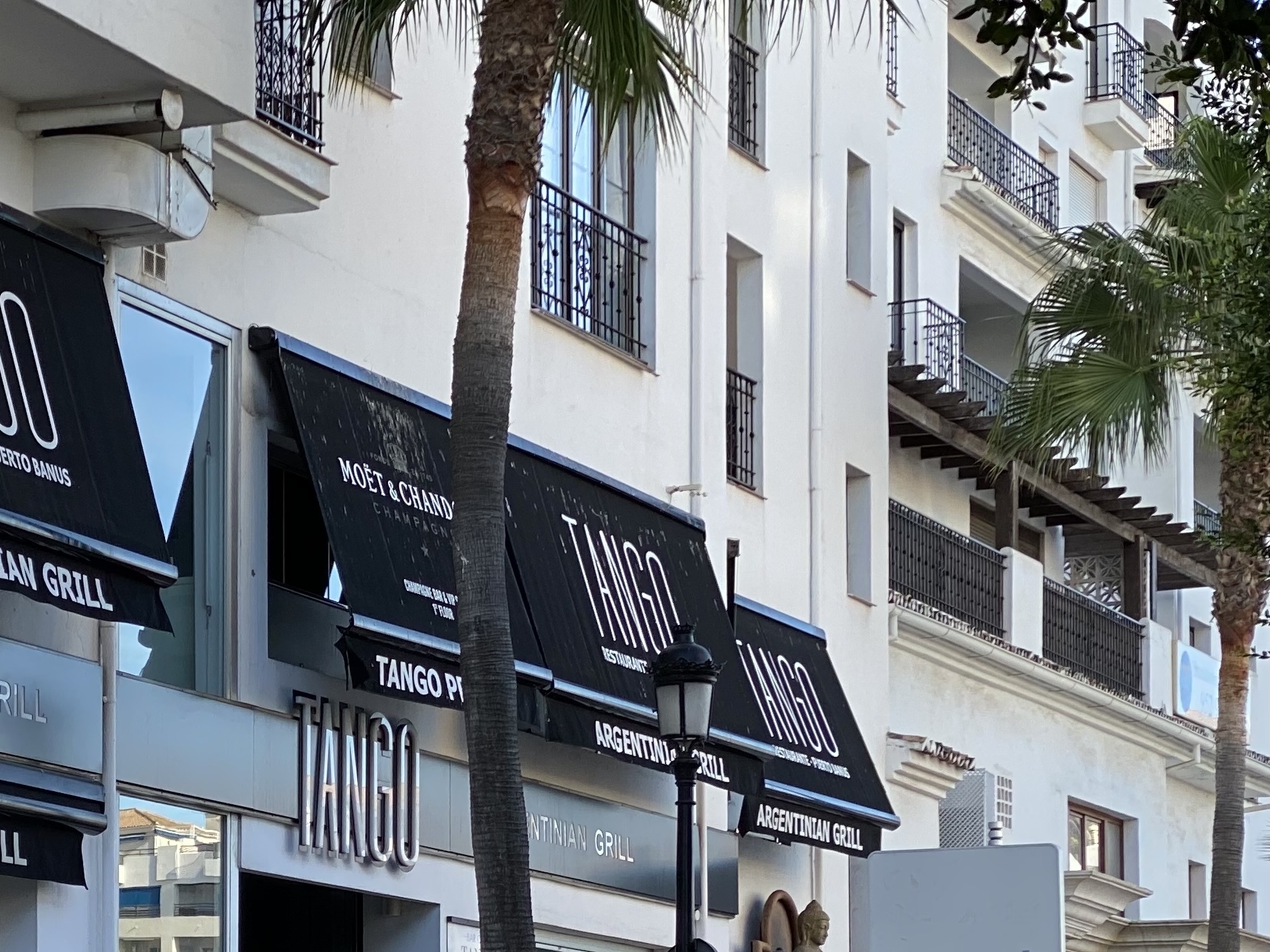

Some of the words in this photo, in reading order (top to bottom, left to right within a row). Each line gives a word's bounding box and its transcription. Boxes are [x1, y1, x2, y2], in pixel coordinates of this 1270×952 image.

[31, 456, 71, 488] BANUS
[338, 457, 386, 497] MOËT
[388, 480, 400, 502] &
[399, 481, 455, 521] CHAND
[373, 502, 450, 538] CHAMPAGN
[42, 562, 114, 611] GRILL
[561, 513, 681, 655] TANGO
[376, 655, 442, 698] TANGO
[735, 639, 839, 758] TANGO
[595, 720, 676, 765] ARGENTINI
[293, 690, 420, 873] TANGO
[594, 828, 635, 863] GRILL
[756, 803, 830, 843] ARGENTINIAN
[832, 822, 863, 851] GRILL
